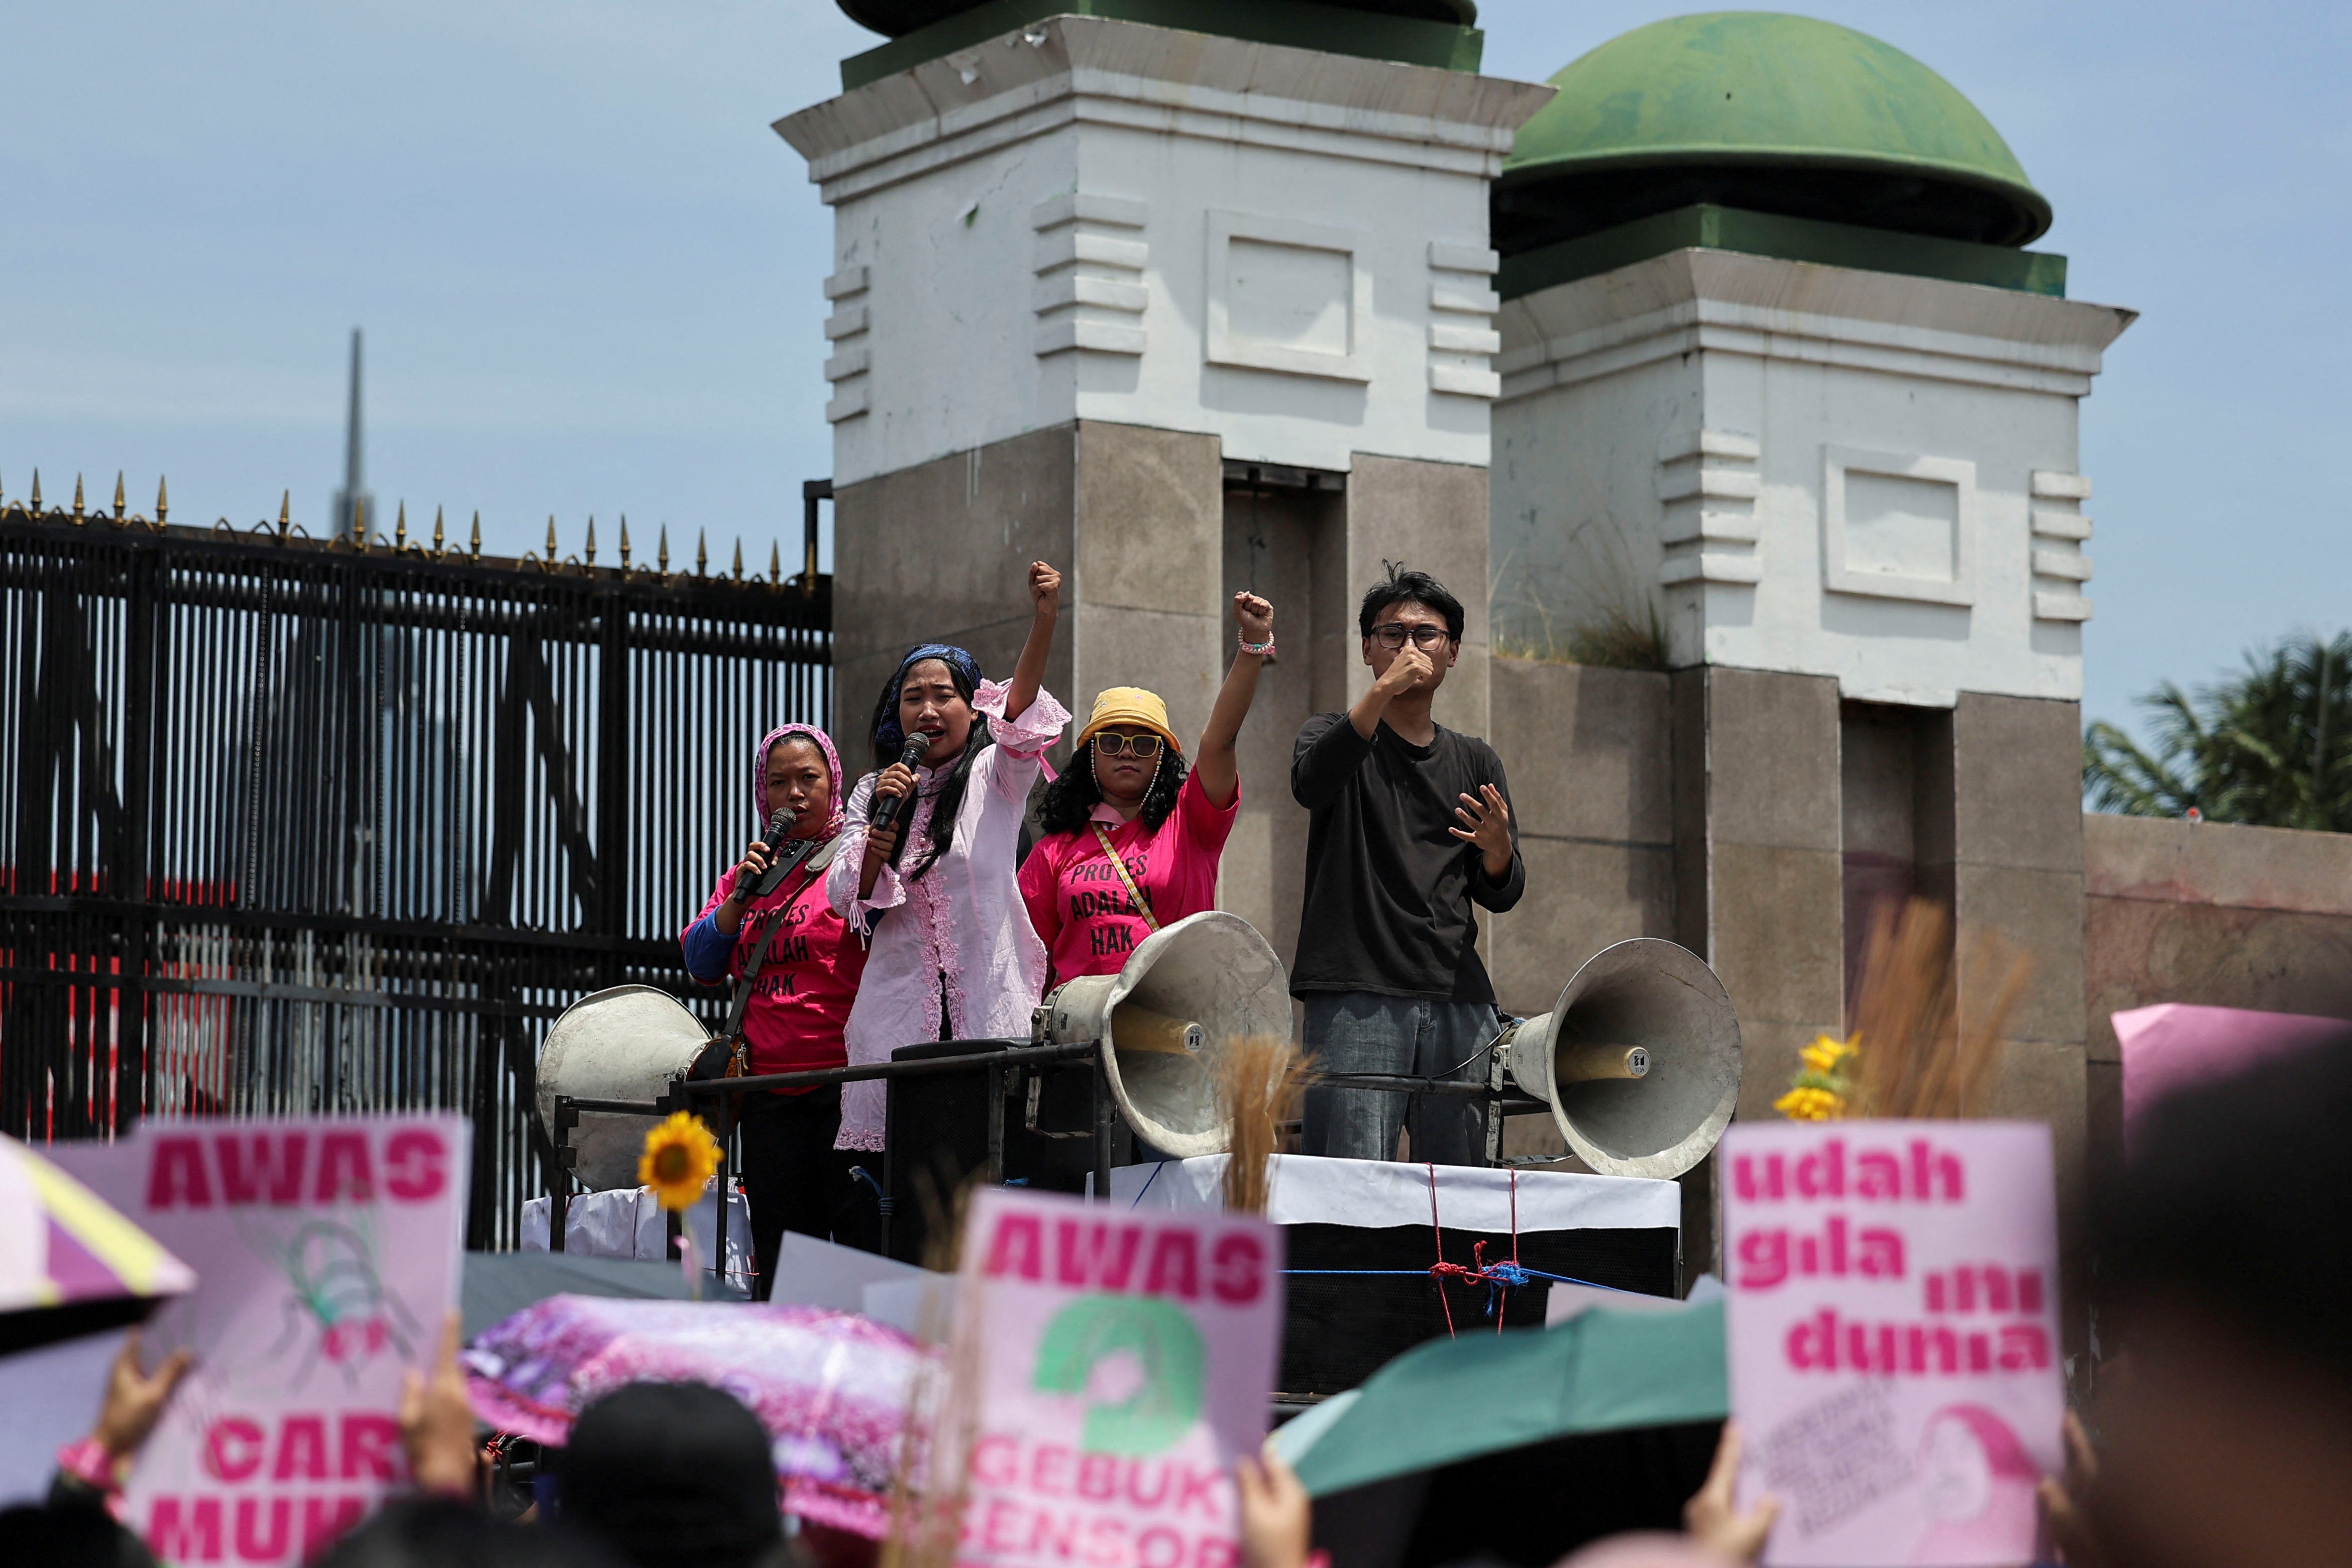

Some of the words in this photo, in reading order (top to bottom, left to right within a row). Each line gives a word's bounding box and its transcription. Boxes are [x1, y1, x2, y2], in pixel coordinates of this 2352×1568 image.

[1070, 854, 1147, 885] PROES
[744, 904, 809, 931] PRES
[1071, 885, 1154, 922] ADALAH
[1091, 925, 1135, 955] HAK
[757, 973, 797, 997] HAK
[144, 1129, 449, 1211] AWAS
[1733, 1137, 1966, 1202] udah
[983, 1212, 1264, 1308] AWAS
[1736, 1214, 1906, 1290] gila
[1923, 1264, 2044, 1314] ini
[1785, 1308, 2050, 1374] dunia
[206, 1414, 405, 1483] CAR
[971, 1434, 1227, 1518] GEBUK
